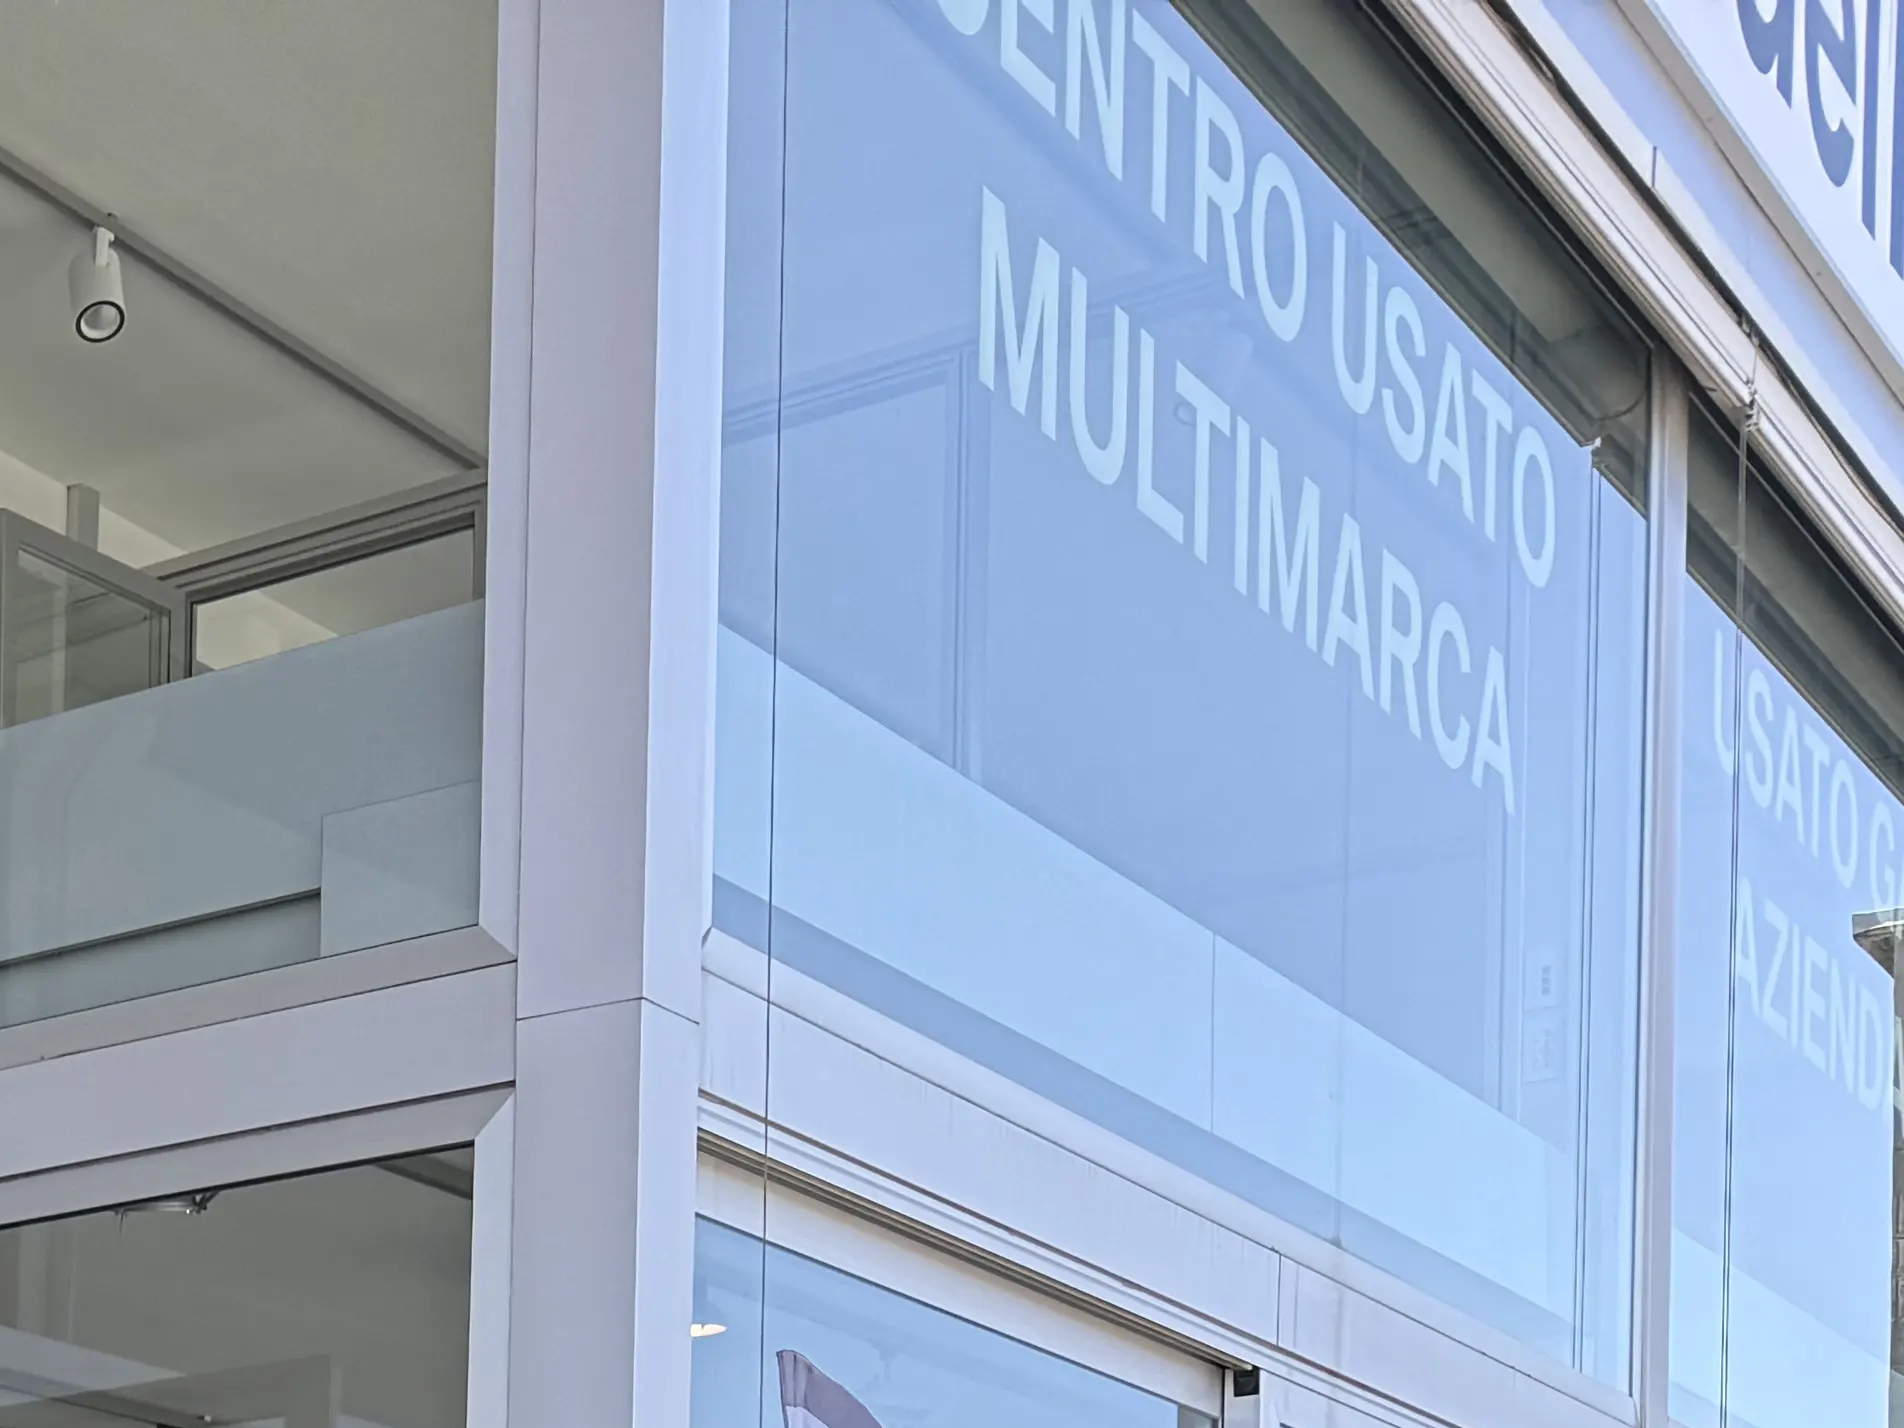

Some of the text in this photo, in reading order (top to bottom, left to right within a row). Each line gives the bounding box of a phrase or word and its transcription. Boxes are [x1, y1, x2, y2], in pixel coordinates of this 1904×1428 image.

[937, 0, 1554, 588] ENTRO USATO
[979, 185, 1516, 815] MULTIMARCA
[1714, 629, 1858, 888] USATO
